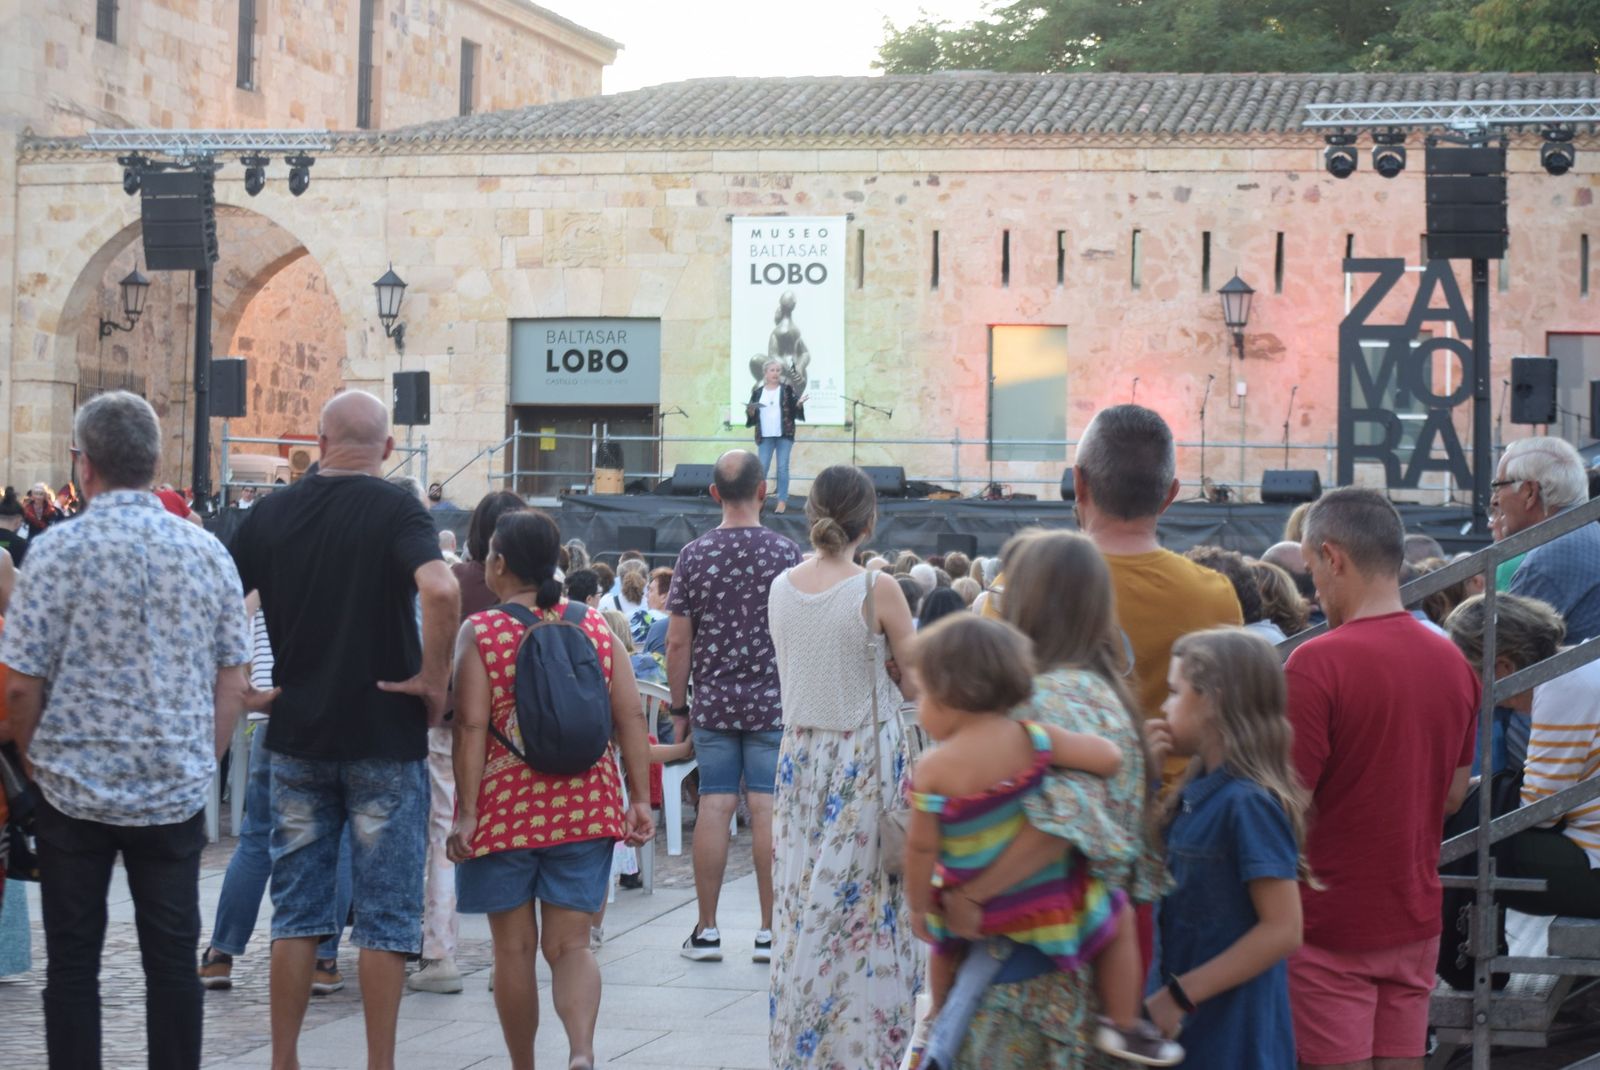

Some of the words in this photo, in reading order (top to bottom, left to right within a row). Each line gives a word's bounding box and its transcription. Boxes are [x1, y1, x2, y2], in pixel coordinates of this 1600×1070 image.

[751, 228, 828, 238] MUSEO
[750, 244, 828, 257] BALTASAR
[750, 263, 828, 285] LOBO
[546, 330, 627, 344] BALTASAR
[546, 349, 629, 373] LOBO
